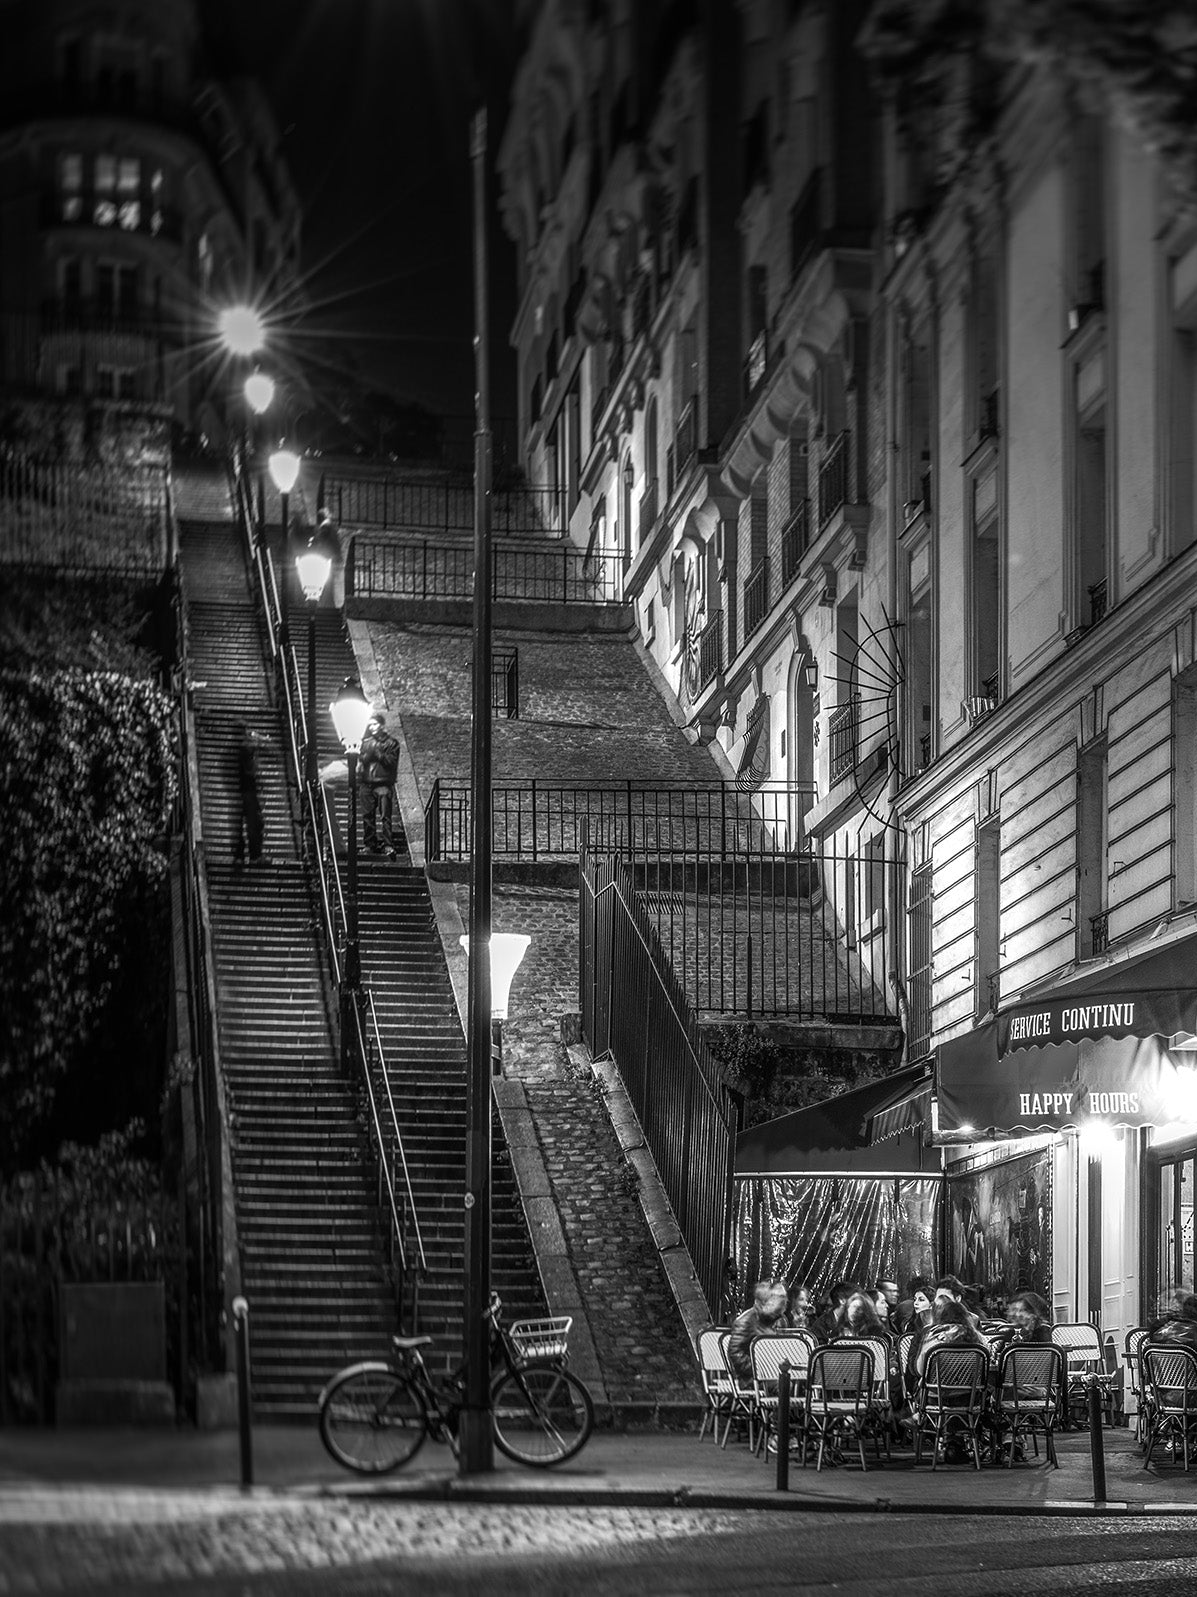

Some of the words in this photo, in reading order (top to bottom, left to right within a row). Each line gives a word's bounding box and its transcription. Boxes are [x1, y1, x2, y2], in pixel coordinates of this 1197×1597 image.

[1062, 1003, 1135, 1032] CONTINU
[1019, 1093, 1074, 1116] HAPPY
[1089, 1092, 1140, 1114] HOURS
